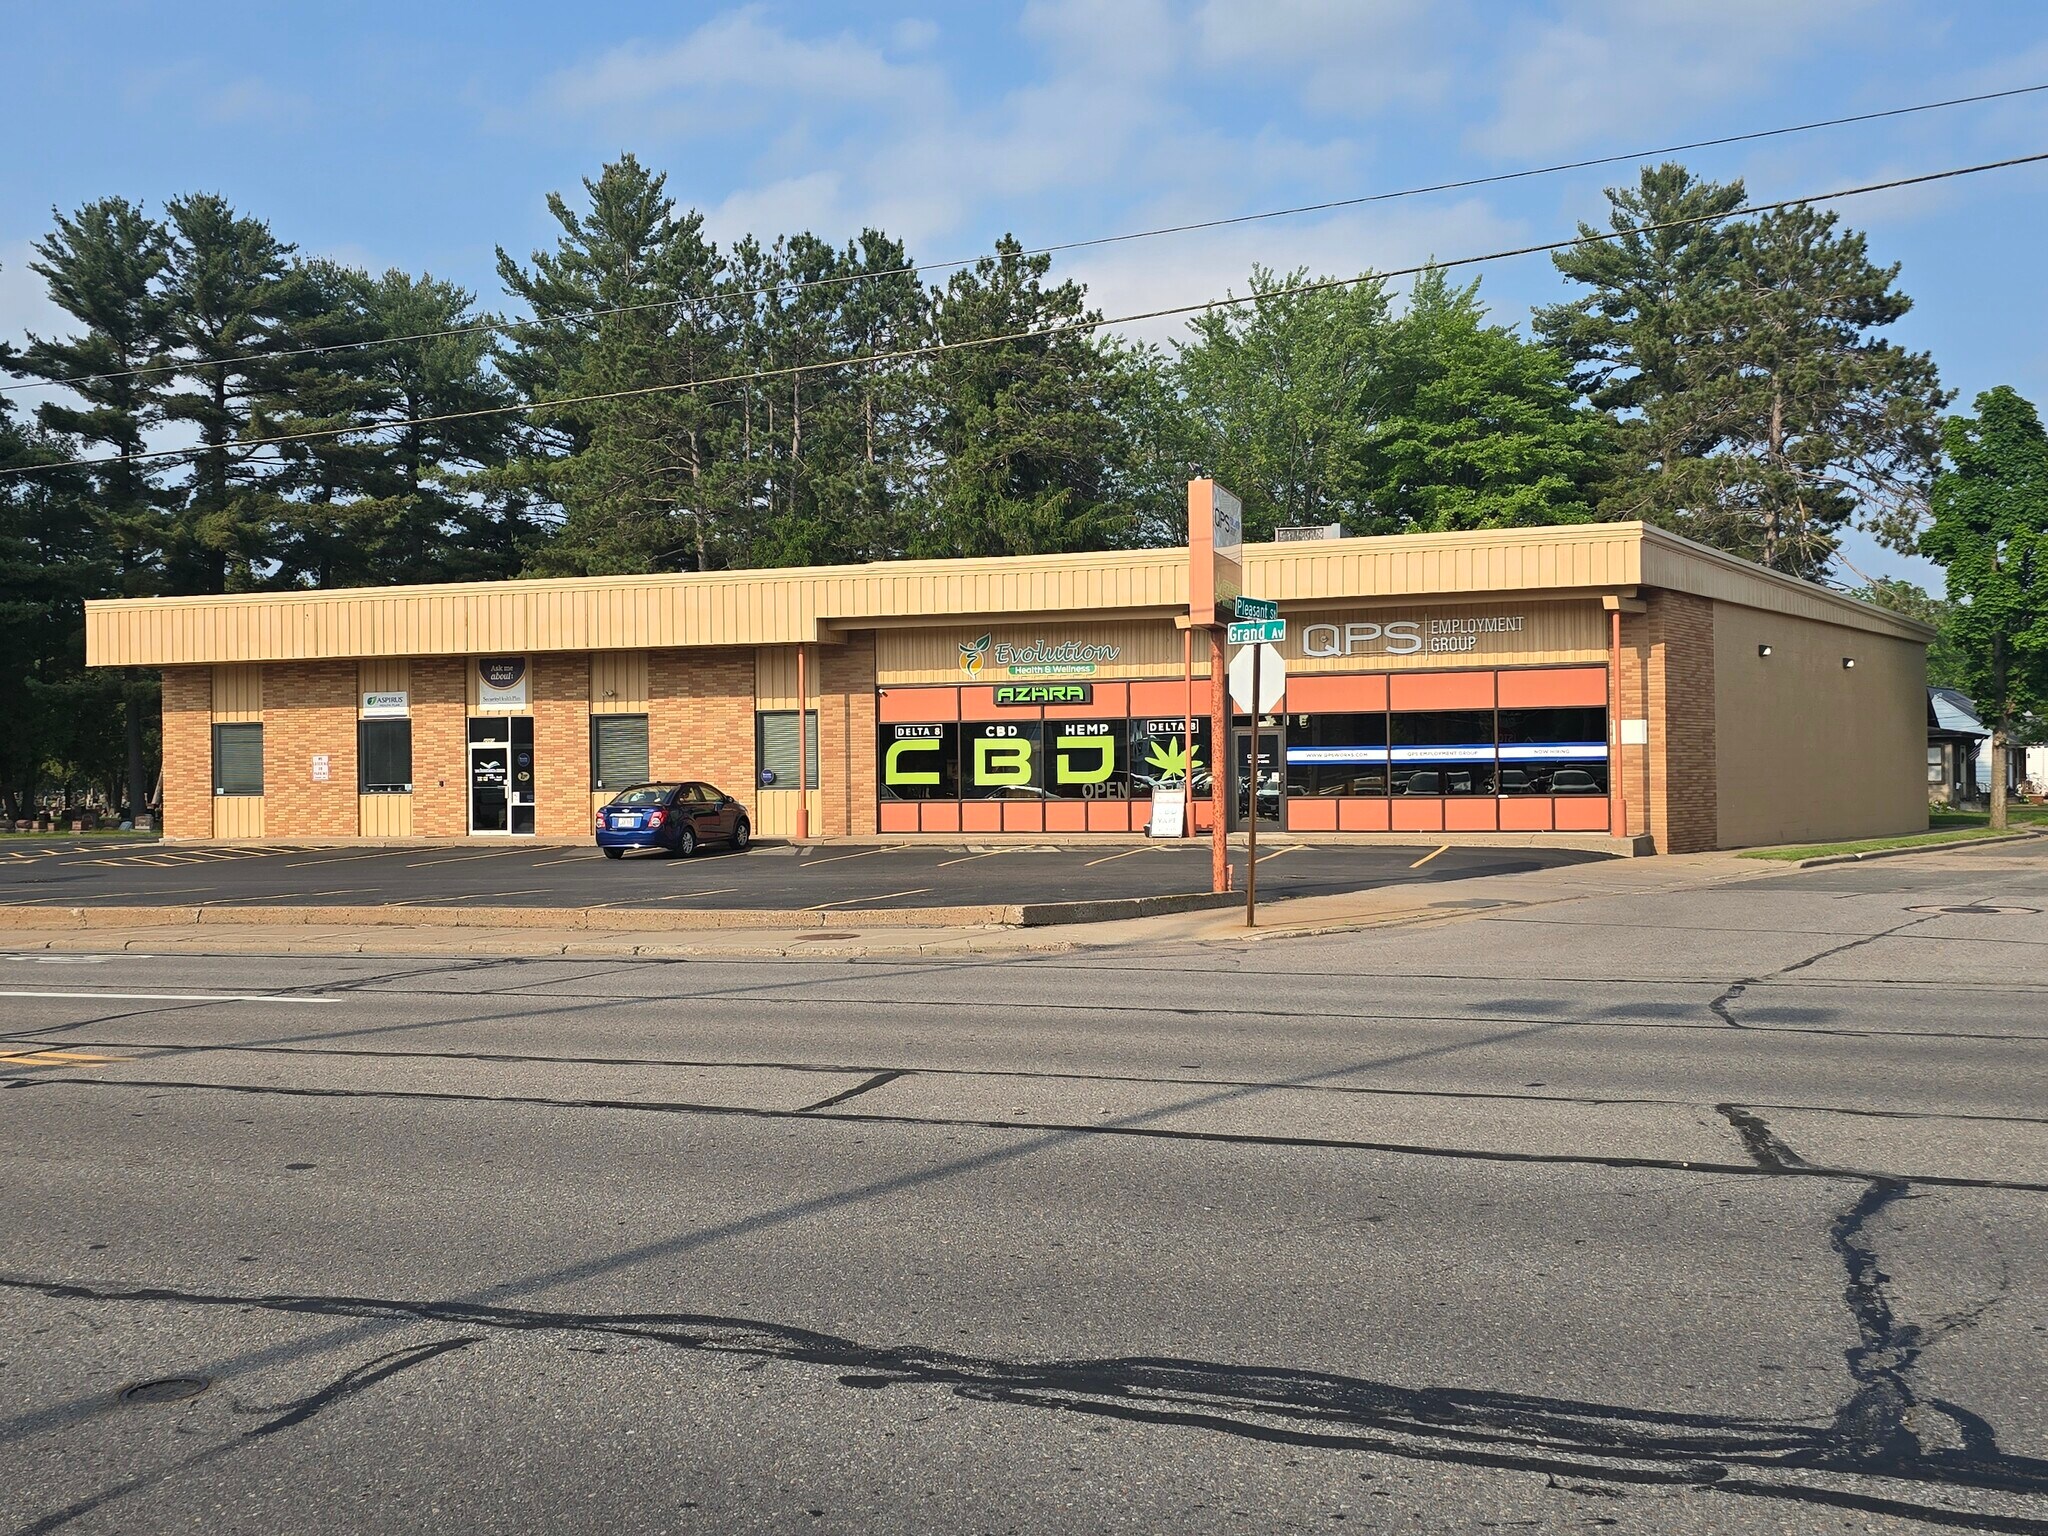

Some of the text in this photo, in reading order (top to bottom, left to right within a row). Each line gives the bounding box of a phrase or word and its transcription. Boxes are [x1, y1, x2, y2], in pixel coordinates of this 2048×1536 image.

[1237, 599, 1268, 619] Pleasant
[1269, 608, 1277, 620] St
[1431, 616, 1525, 634] EMPLOYMENT
[1229, 624, 1284, 642] Grand Av
[1303, 621, 1422, 657] QPS
[1431, 636, 1477, 652] GROUP
[995, 639, 1120, 664] Evolution
[490, 664, 503, 672] Ask
[1015, 664, 1091, 674] Health & Wellness
[377, 696, 403, 704] ASPIRUS
[897, 727, 941, 736] DELTA 8
[985, 725, 1018, 737] CBD
[1065, 723, 1109, 736] HEMP
[1149, 722, 1185, 732] DELTA
[1082, 781, 1128, 799] OPEN
